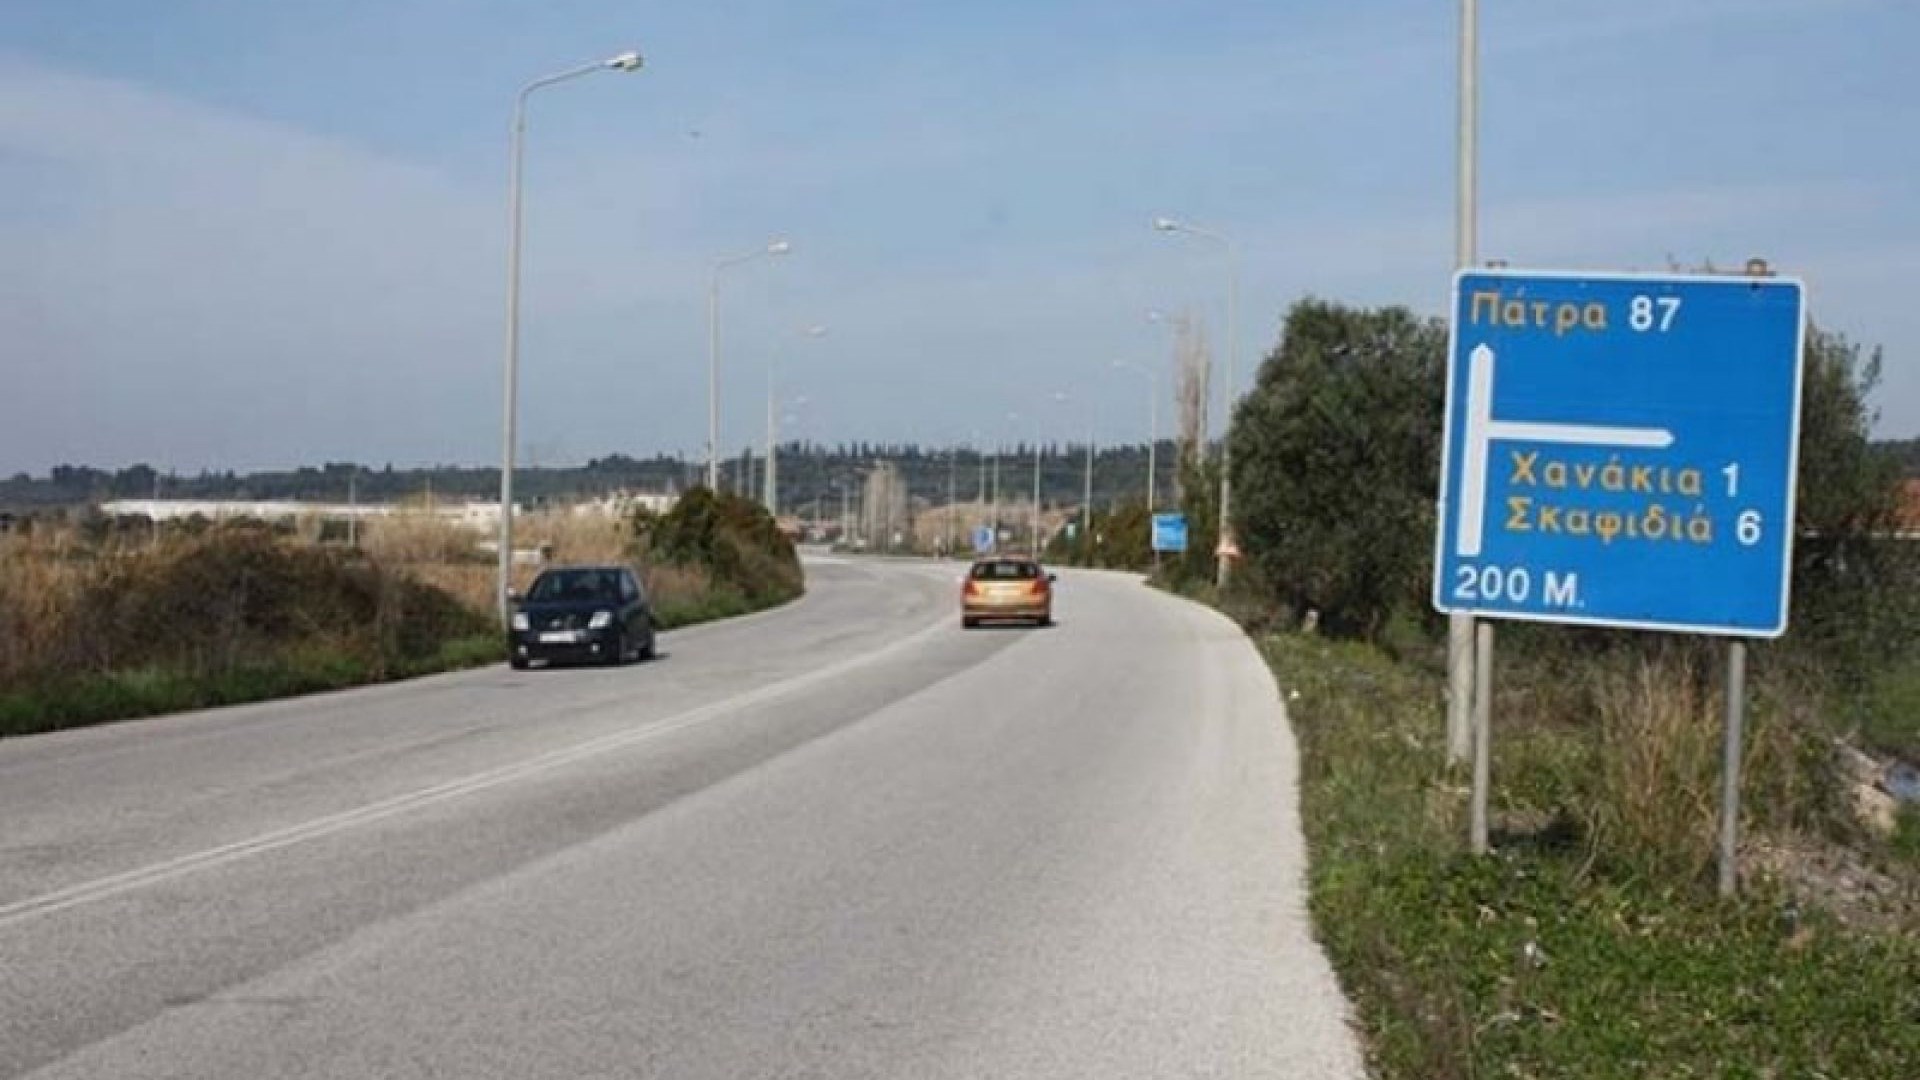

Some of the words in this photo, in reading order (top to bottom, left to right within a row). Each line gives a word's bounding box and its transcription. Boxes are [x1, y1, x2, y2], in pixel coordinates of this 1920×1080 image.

[1471, 288, 1607, 336] Πάτρα
[1629, 295, 1681, 332] 87
[1510, 450, 1702, 493] Χανάκια
[1722, 463, 1739, 497] 1
[1505, 497, 1712, 543] Σκαφιδιά
[1736, 510, 1761, 545] 6
[1454, 565, 1529, 601] 200
